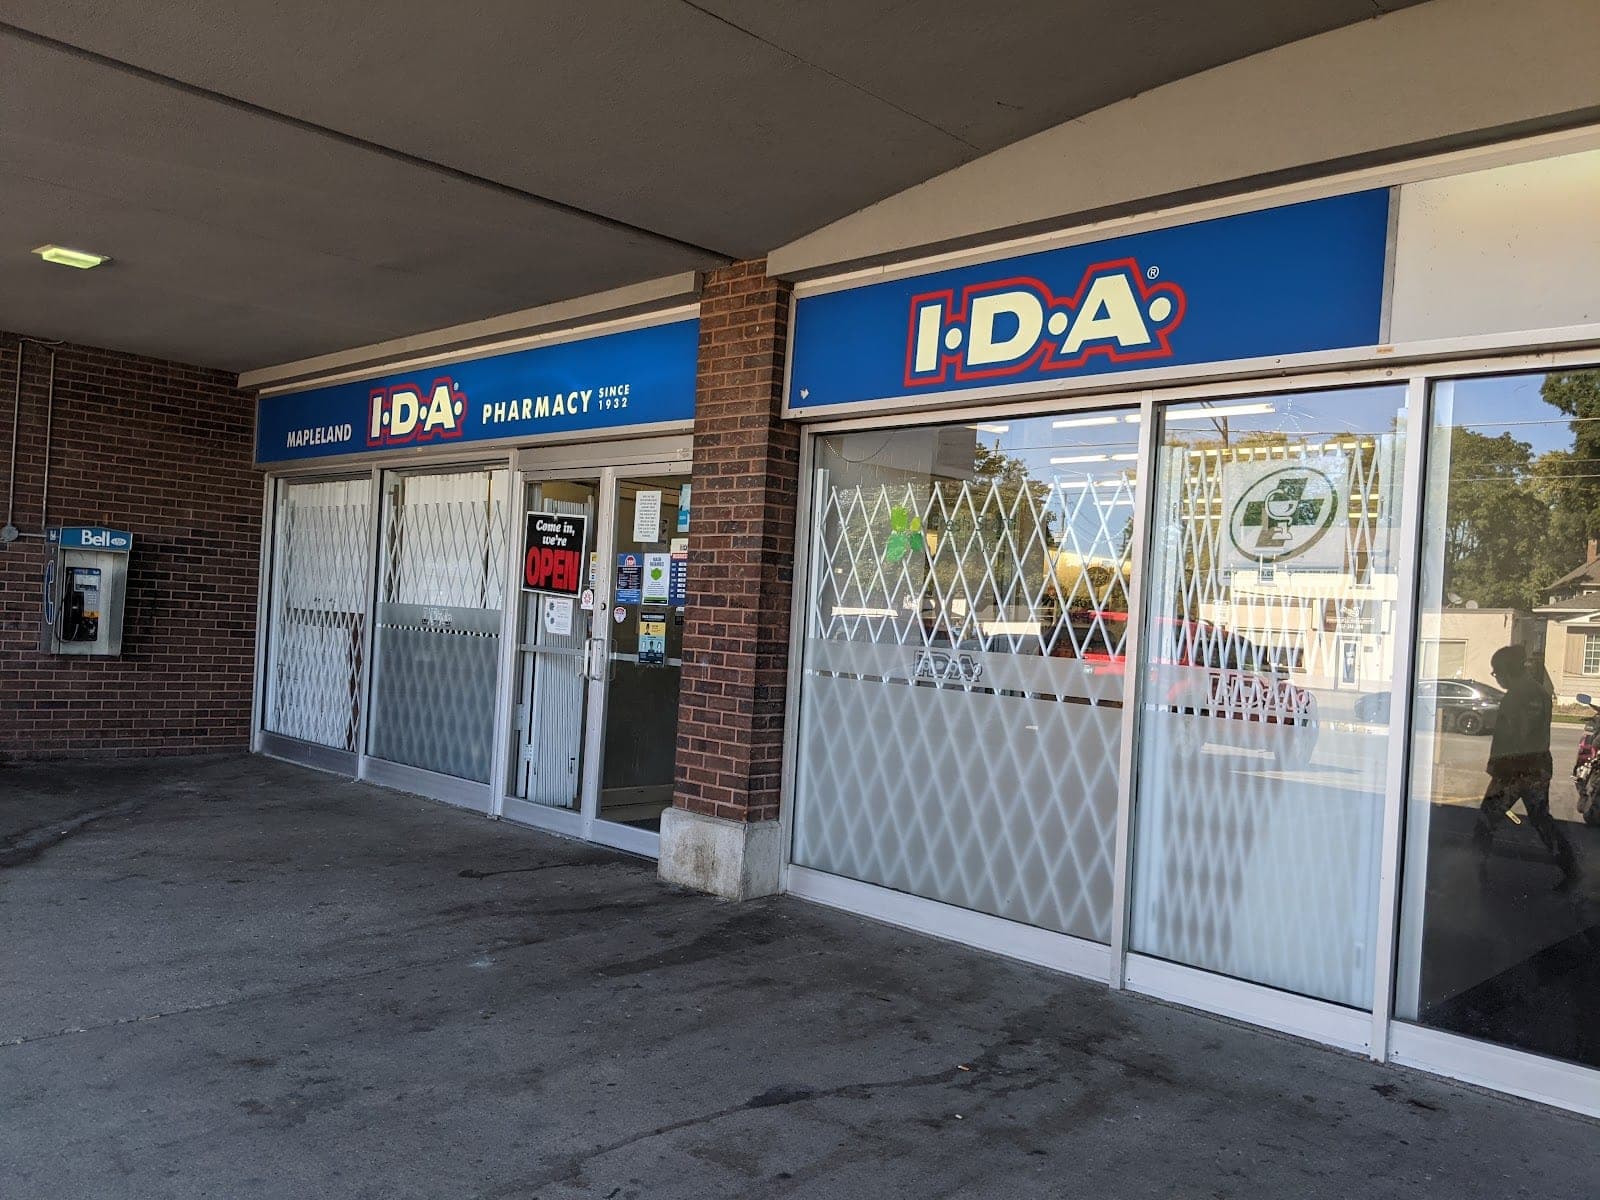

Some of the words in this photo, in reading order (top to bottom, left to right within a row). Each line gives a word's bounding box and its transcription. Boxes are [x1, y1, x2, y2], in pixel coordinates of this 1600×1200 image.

[597, 383, 631, 398] SINCE
[598, 396, 629, 411] 1932
[286, 423, 353, 449] MAPLELAND
[481, 388, 594, 425] PHARMACY
[535, 519, 562, 533] Come
[562, 521, 576, 536] in,
[81, 529, 111, 547] Bell
[542, 534, 567, 546] we're
[525, 545, 580, 591] OPEN
